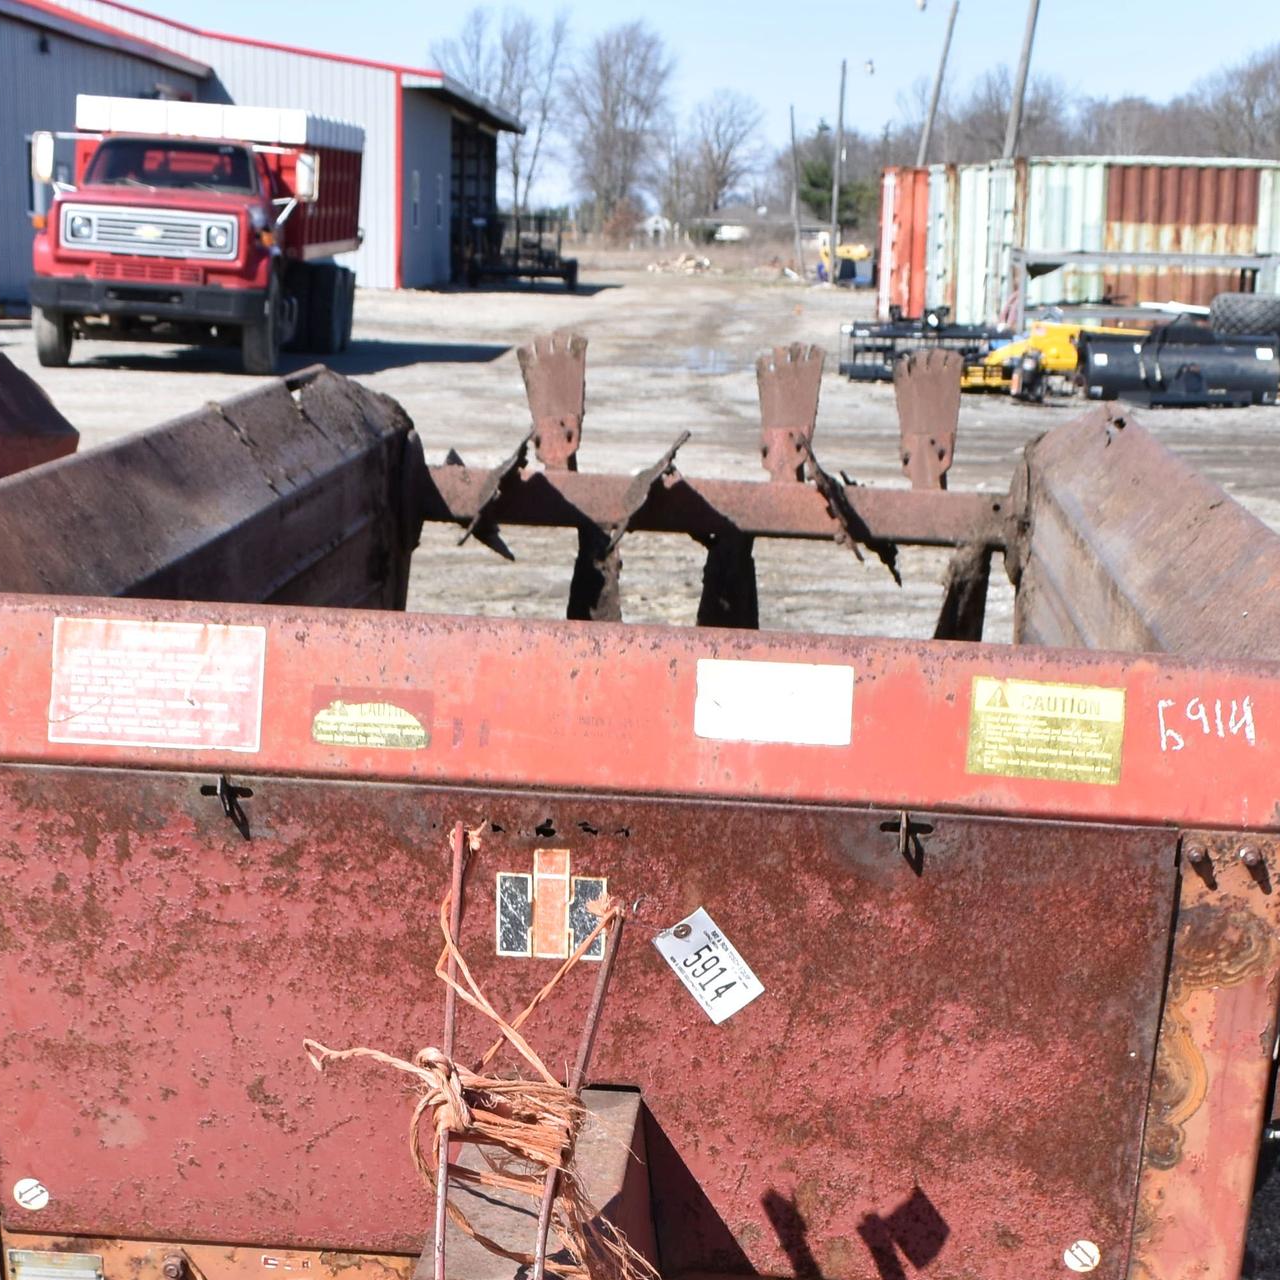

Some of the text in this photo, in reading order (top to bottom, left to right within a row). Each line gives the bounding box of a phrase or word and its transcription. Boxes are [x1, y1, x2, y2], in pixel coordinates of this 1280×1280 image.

[1021, 694, 1102, 716] CAUTION
[1157, 695, 1256, 752] 5914
[682, 944, 739, 1004] 5914
